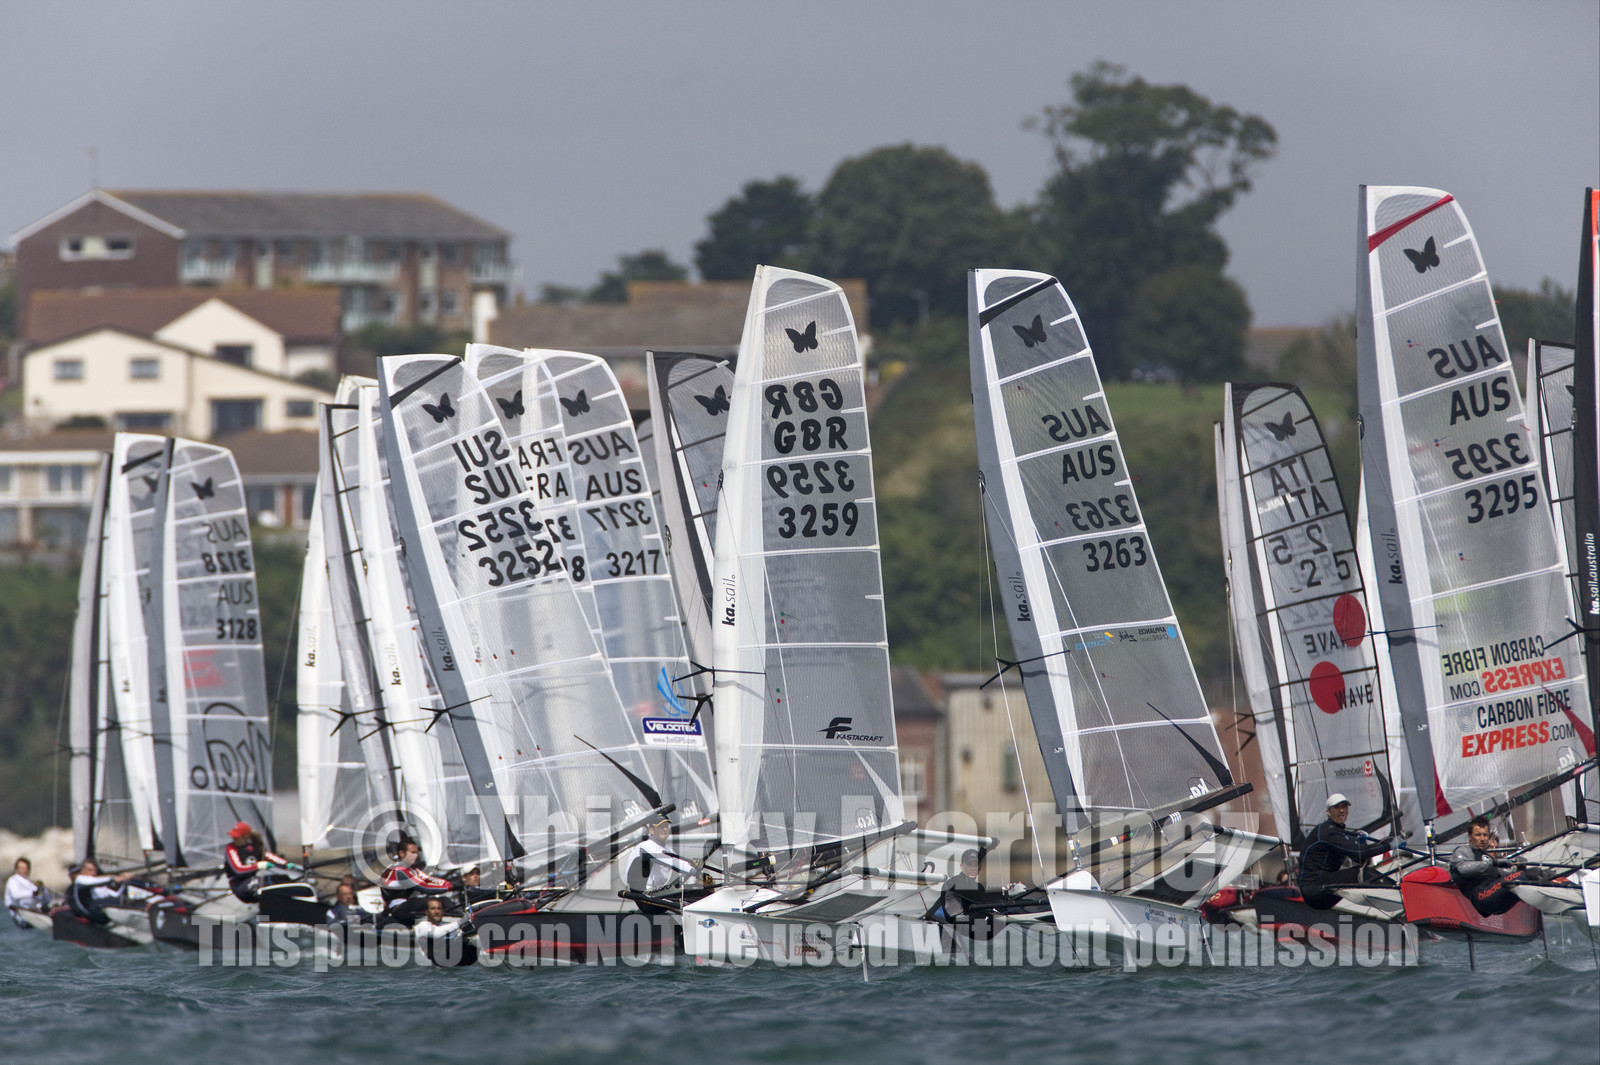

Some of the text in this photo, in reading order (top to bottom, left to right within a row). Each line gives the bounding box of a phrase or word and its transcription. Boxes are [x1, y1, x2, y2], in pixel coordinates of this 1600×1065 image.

[1450, 376, 1511, 426] AUS
[774, 416, 848, 454] GBR
[1062, 444, 1116, 485] AUS
[465, 463, 522, 505] SUI
[586, 469, 642, 501] AUS
[1465, 474, 1538, 523] 3295
[778, 502, 858, 538] 3259
[1281, 485, 1330, 523] ITA
[478, 540, 561, 587] 3252
[606, 550, 660, 577] 3217
[1083, 536, 1147, 572] 3263
[217, 581, 254, 606] AUS
[216, 617, 257, 640] 3128
[1334, 684, 1374, 711] WAVE
[1477, 689, 1571, 728] CARBON FIBRE
[646, 720, 697, 732] VELOCITEK
[836, 733, 884, 742] FASTACRAFT
